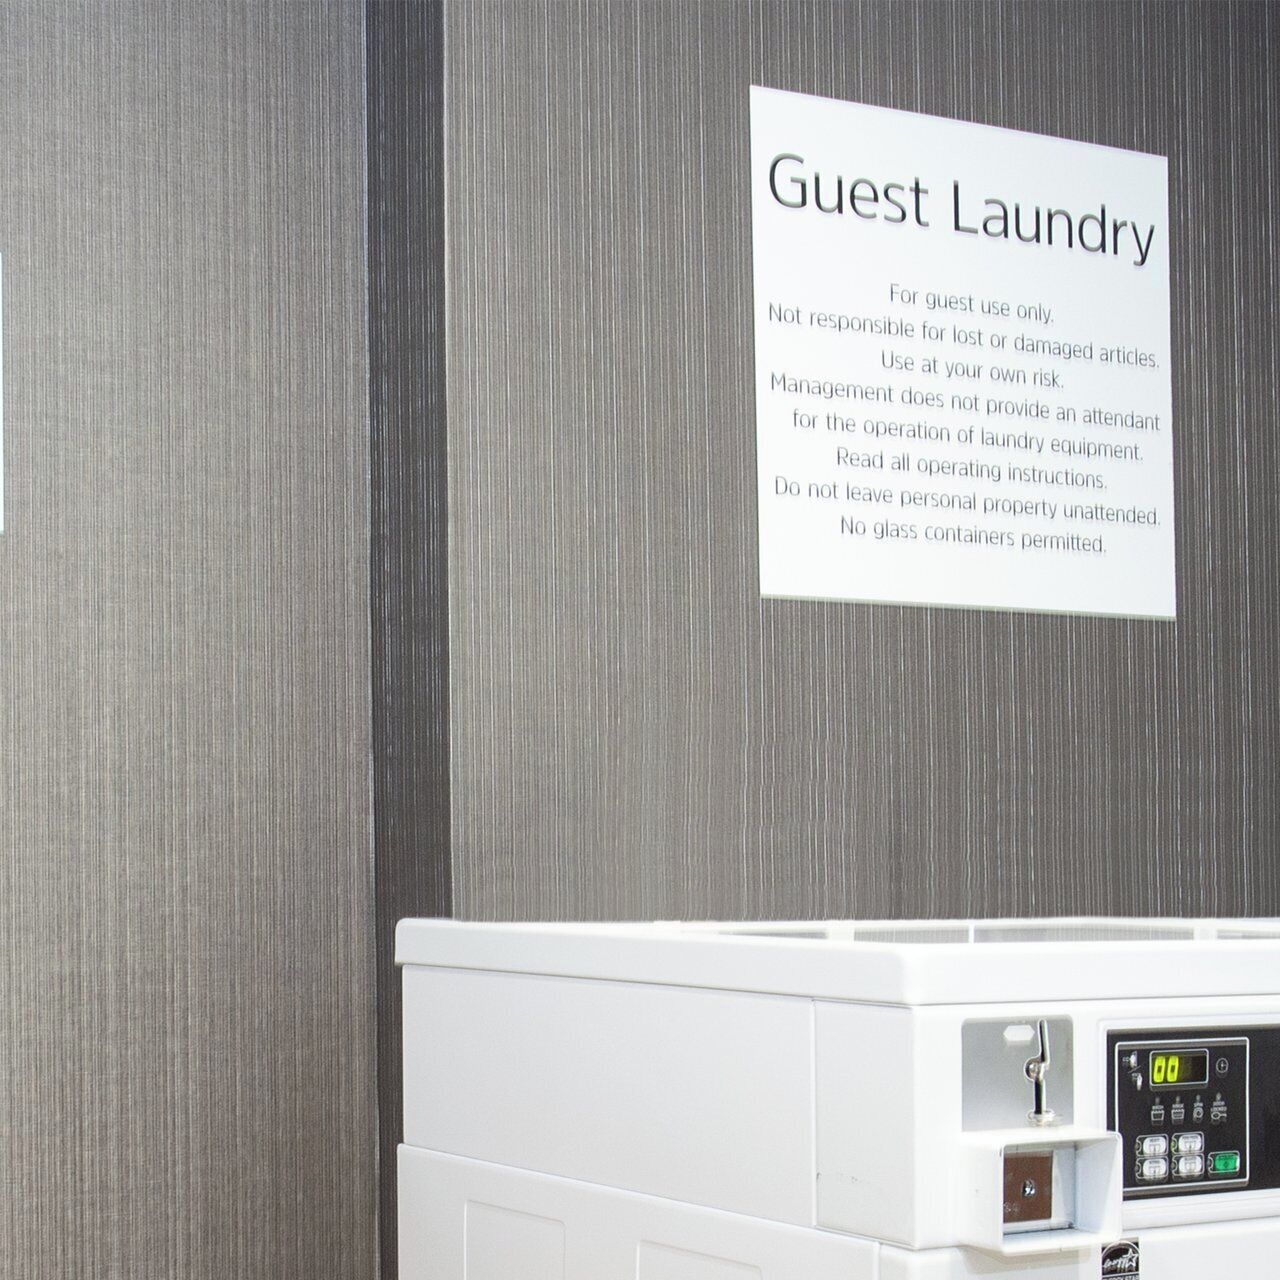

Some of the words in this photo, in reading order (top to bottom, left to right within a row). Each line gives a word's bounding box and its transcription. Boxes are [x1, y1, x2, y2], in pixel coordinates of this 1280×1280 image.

[769, 153, 929, 227] Guest
[953, 180, 1155, 269] Laundry
[891, 283, 918, 304] For
[926, 293, 973, 312] guest
[981, 300, 1010, 317] use
[1017, 303, 1053, 325] only.
[769, 302, 801, 324] Not
[810, 312, 914, 337] responsible
[922, 321, 946, 341] for
[953, 325, 983, 346] lost
[990, 334, 1007, 349] or
[1014, 333, 1093, 360] damaged
[1100, 346, 1159, 368] articles.
[882, 350, 914, 371] Use
[922, 357, 938, 374] at
[946, 362, 983, 379] your
[990, 367, 1026, 384] own
[1034, 368, 1063, 388] risk.
[771, 372, 894, 402] Management
[901, 386, 944, 407] does
[952, 394, 979, 411] not
[987, 399, 1049, 419] provide
[1056, 407, 1076, 422] an
[1083, 408, 1160, 431] attendant
[794, 408, 818, 429] for
[826, 412, 856, 432] the
[864, 420, 950, 442] operation
[958, 425, 974, 444] of
[982, 427, 1044, 453] laundry
[1051, 437, 1143, 460] equipment.
[837, 447, 883, 469] Read
[891, 453, 909, 471] all
[917, 458, 1001, 482] operating
[1009, 466, 1107, 489] instructions.
[775, 476, 800, 496] Do
[809, 482, 838, 499] not
[847, 482, 893, 503] leave
[901, 491, 976, 510] personal
[984, 498, 1057, 519] property
[1064, 504, 1160, 527] unattended.
[841, 515, 866, 535] No
[874, 519, 917, 540] glass
[925, 525, 1014, 546] containers
[1022, 533, 1106, 554] permitted.
[1153, 1055, 1179, 1083] 00
